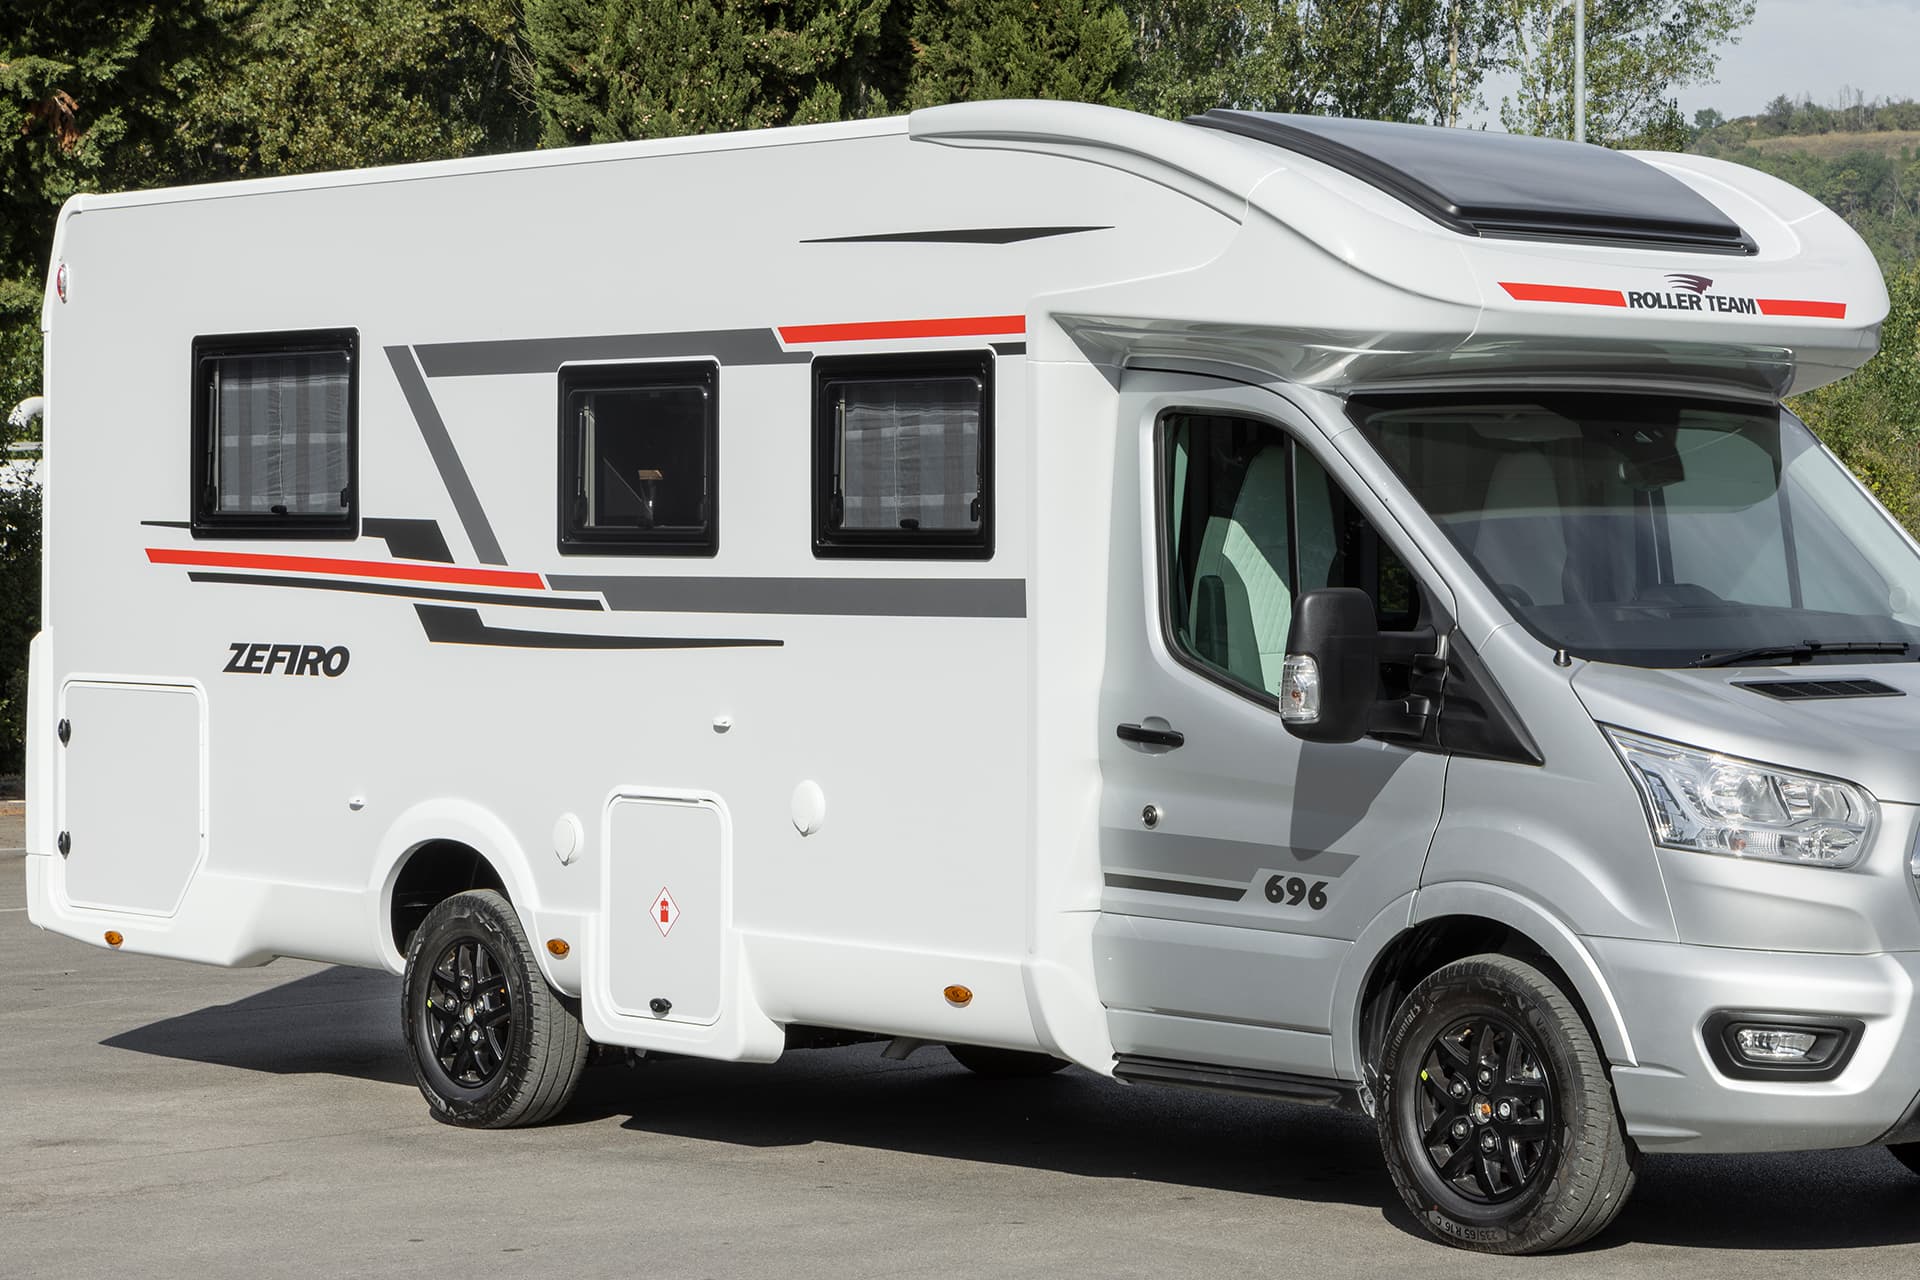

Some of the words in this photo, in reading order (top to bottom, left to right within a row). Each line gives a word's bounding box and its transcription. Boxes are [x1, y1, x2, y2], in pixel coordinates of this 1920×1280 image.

[1627, 291, 1702, 311] ROLLER
[1705, 295, 1758, 315] TEAM
[222, 642, 350, 678] ZEFIRO
[1264, 874, 1329, 911] 696
